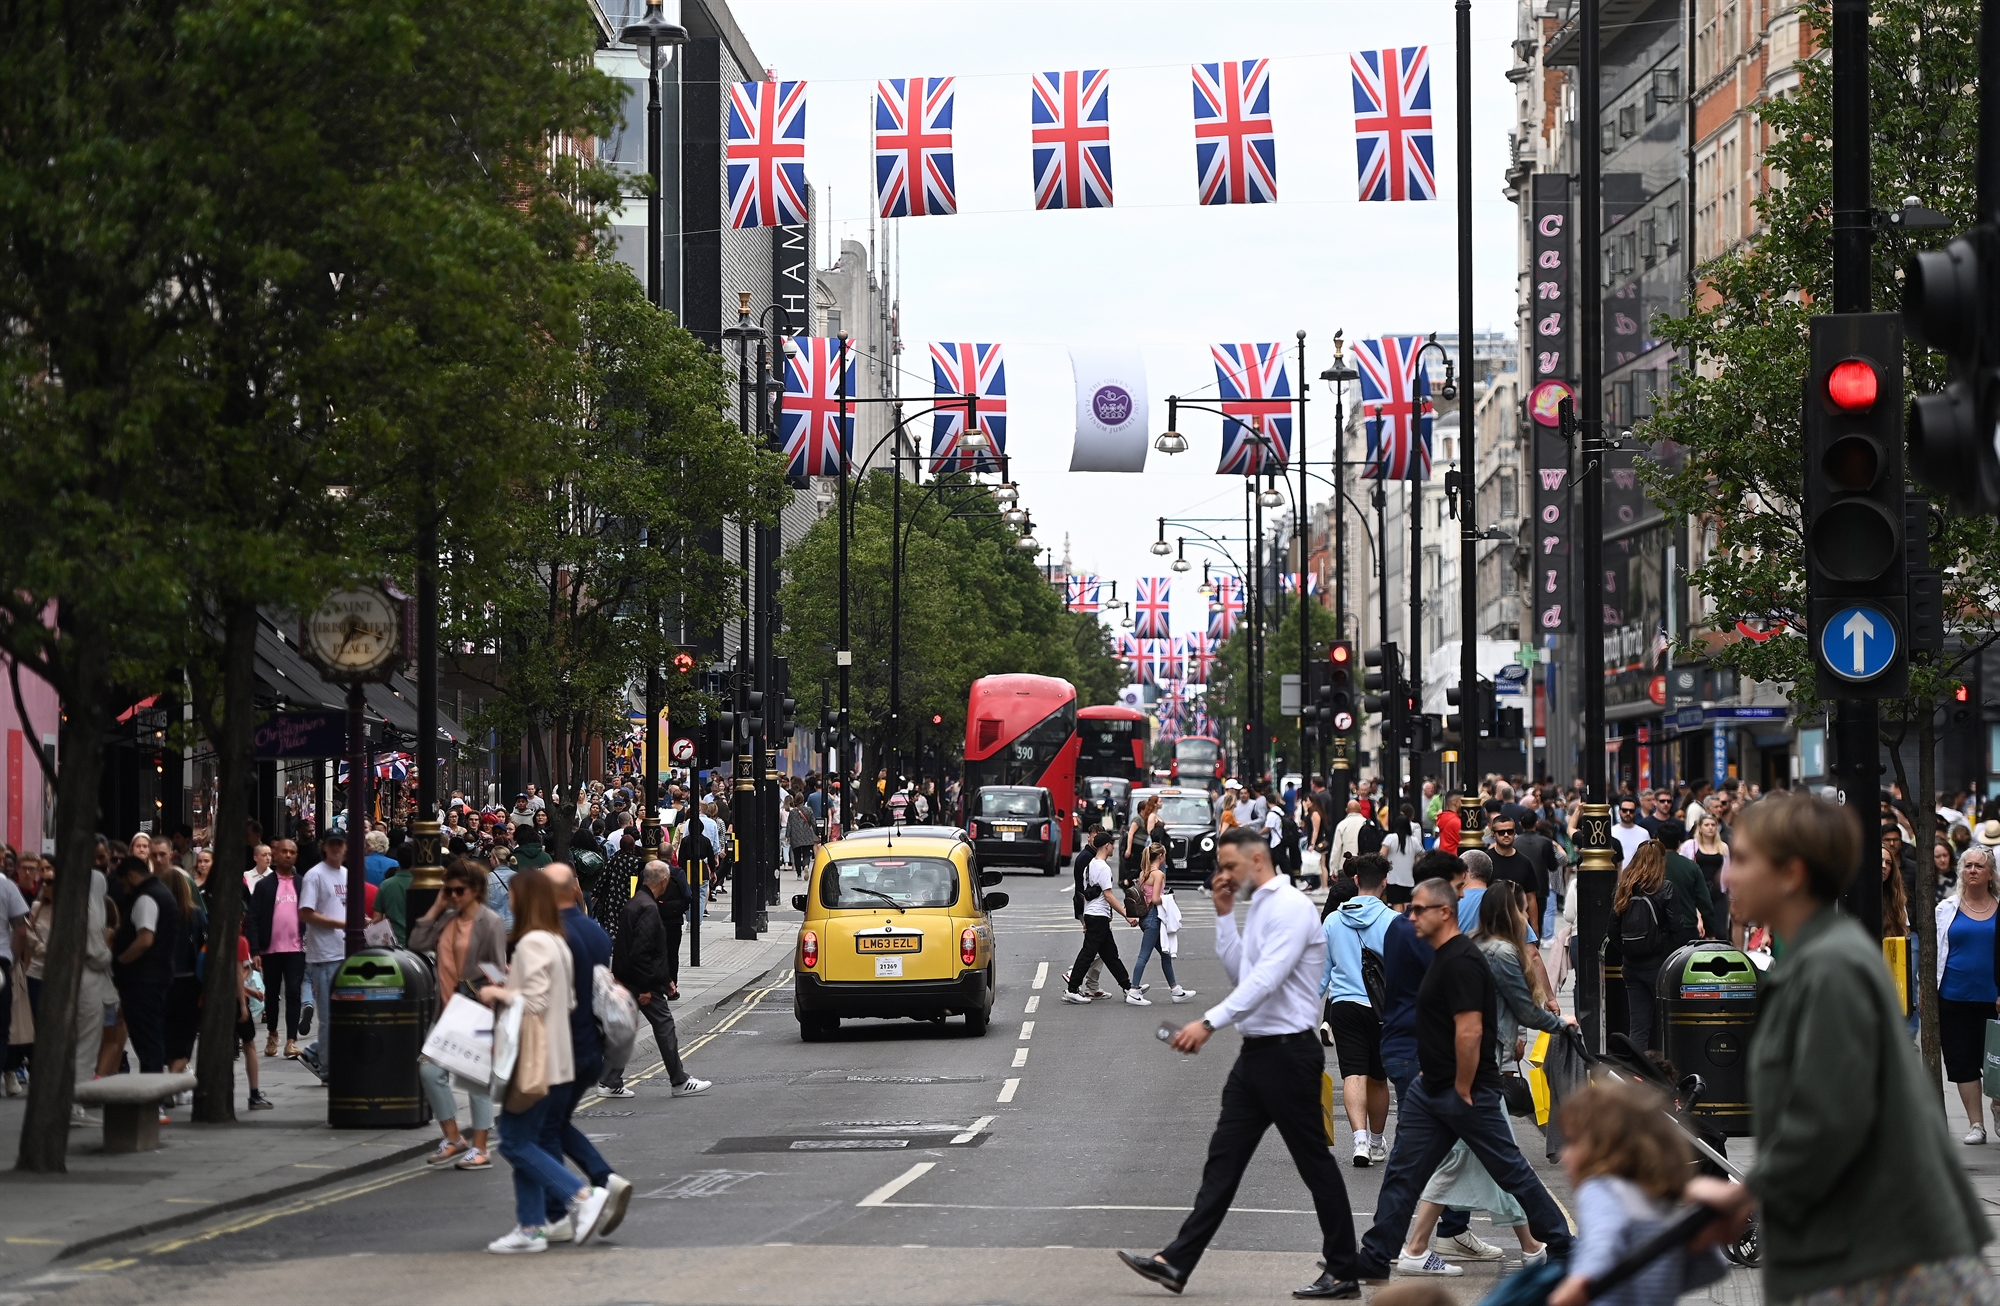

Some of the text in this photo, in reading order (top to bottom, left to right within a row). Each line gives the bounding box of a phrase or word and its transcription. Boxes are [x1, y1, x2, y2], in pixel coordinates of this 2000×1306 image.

[1538, 214, 1567, 628] Candy World
[333, 643, 373, 654] PLACE
[276, 735, 307, 755] Place
[1101, 733, 1113, 743] 98
[1016, 746, 1034, 760] 390
[1715, 729, 1726, 781] MONEY
[1838, 790, 1847, 806] 9
[863, 938, 913, 949] LM63 EZL
[432, 1036, 481, 1064] OFFICE
